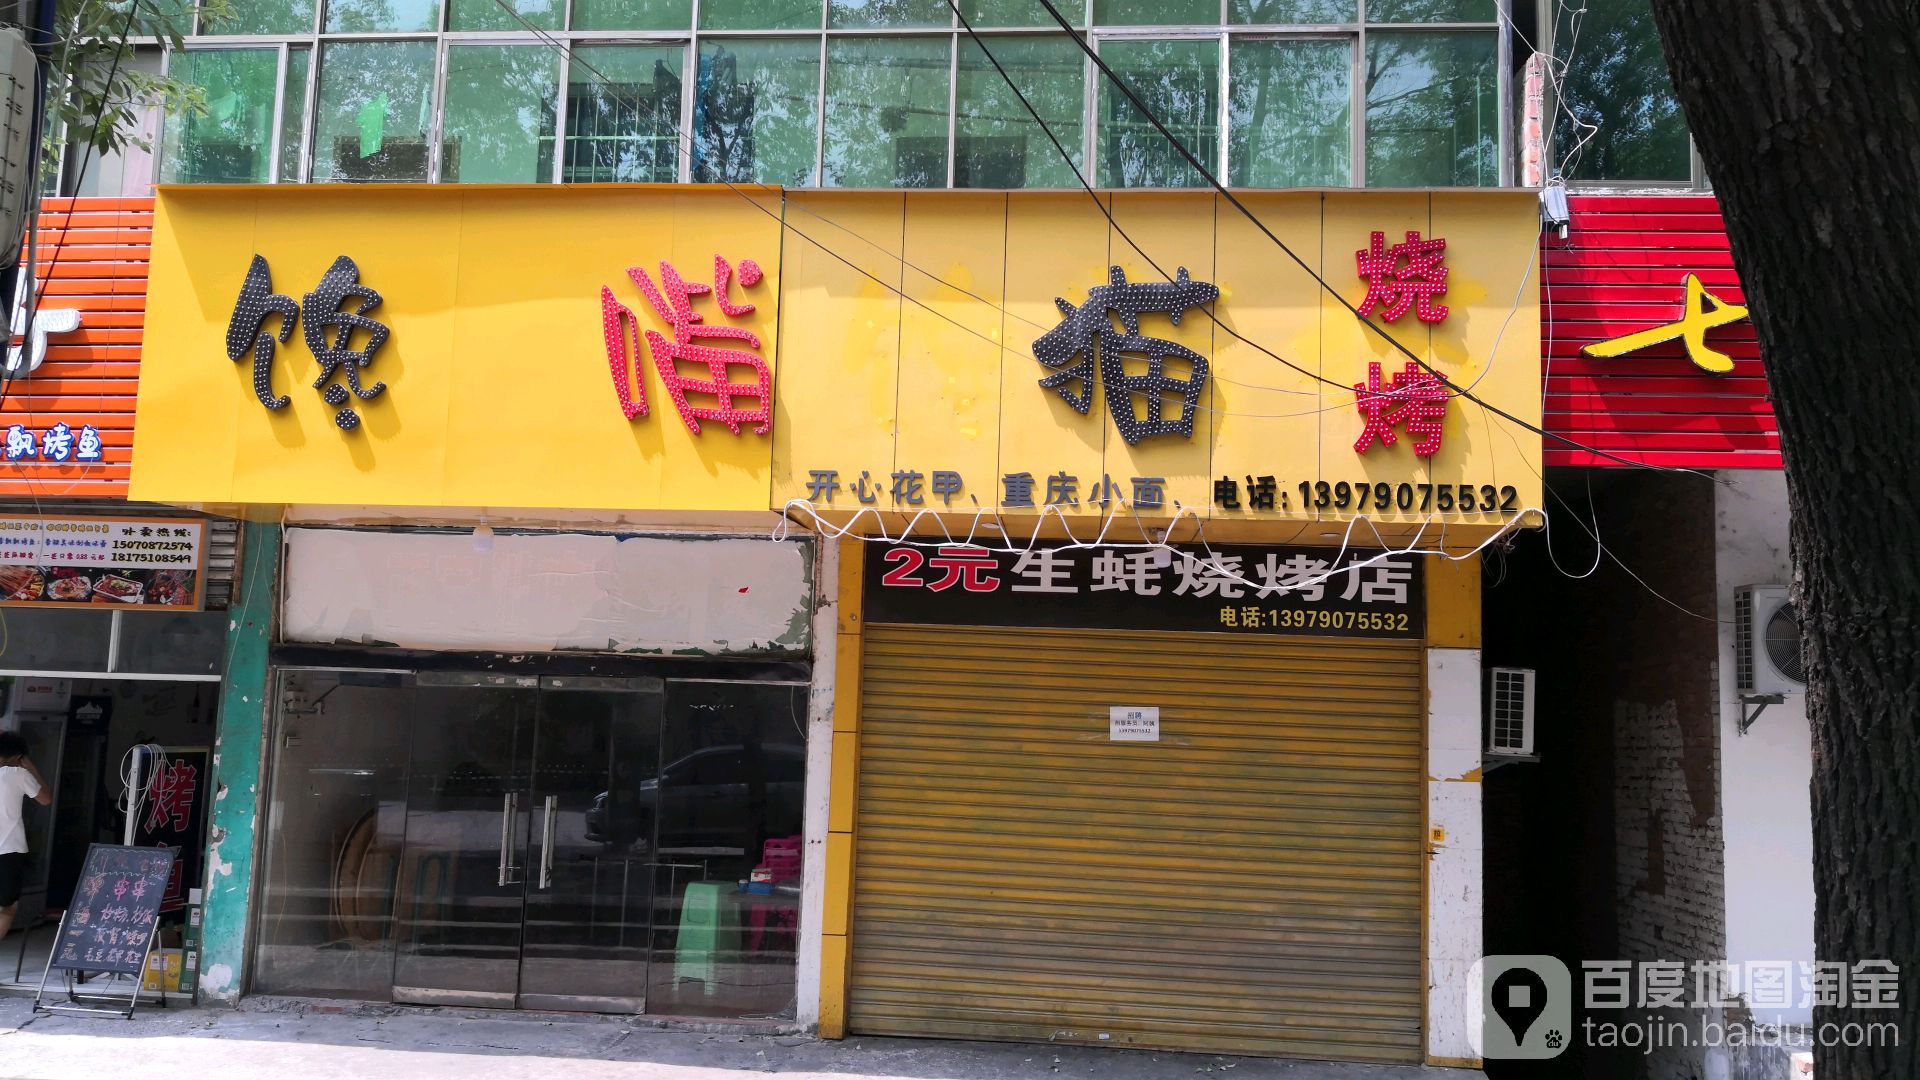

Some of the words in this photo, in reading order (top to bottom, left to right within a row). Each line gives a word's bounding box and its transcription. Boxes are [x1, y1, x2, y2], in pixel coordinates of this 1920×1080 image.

[1353, 230, 1450, 457] 烧烤
[1213, 475, 1518, 513] 电话:13979075532
[111, 552, 191, 563] 18175108549
[112, 539, 193, 550] 15070872574
[882, 547, 1414, 604] 2元生蚝烧烤店
[1219, 606, 1410, 631] 电话:13979075532
